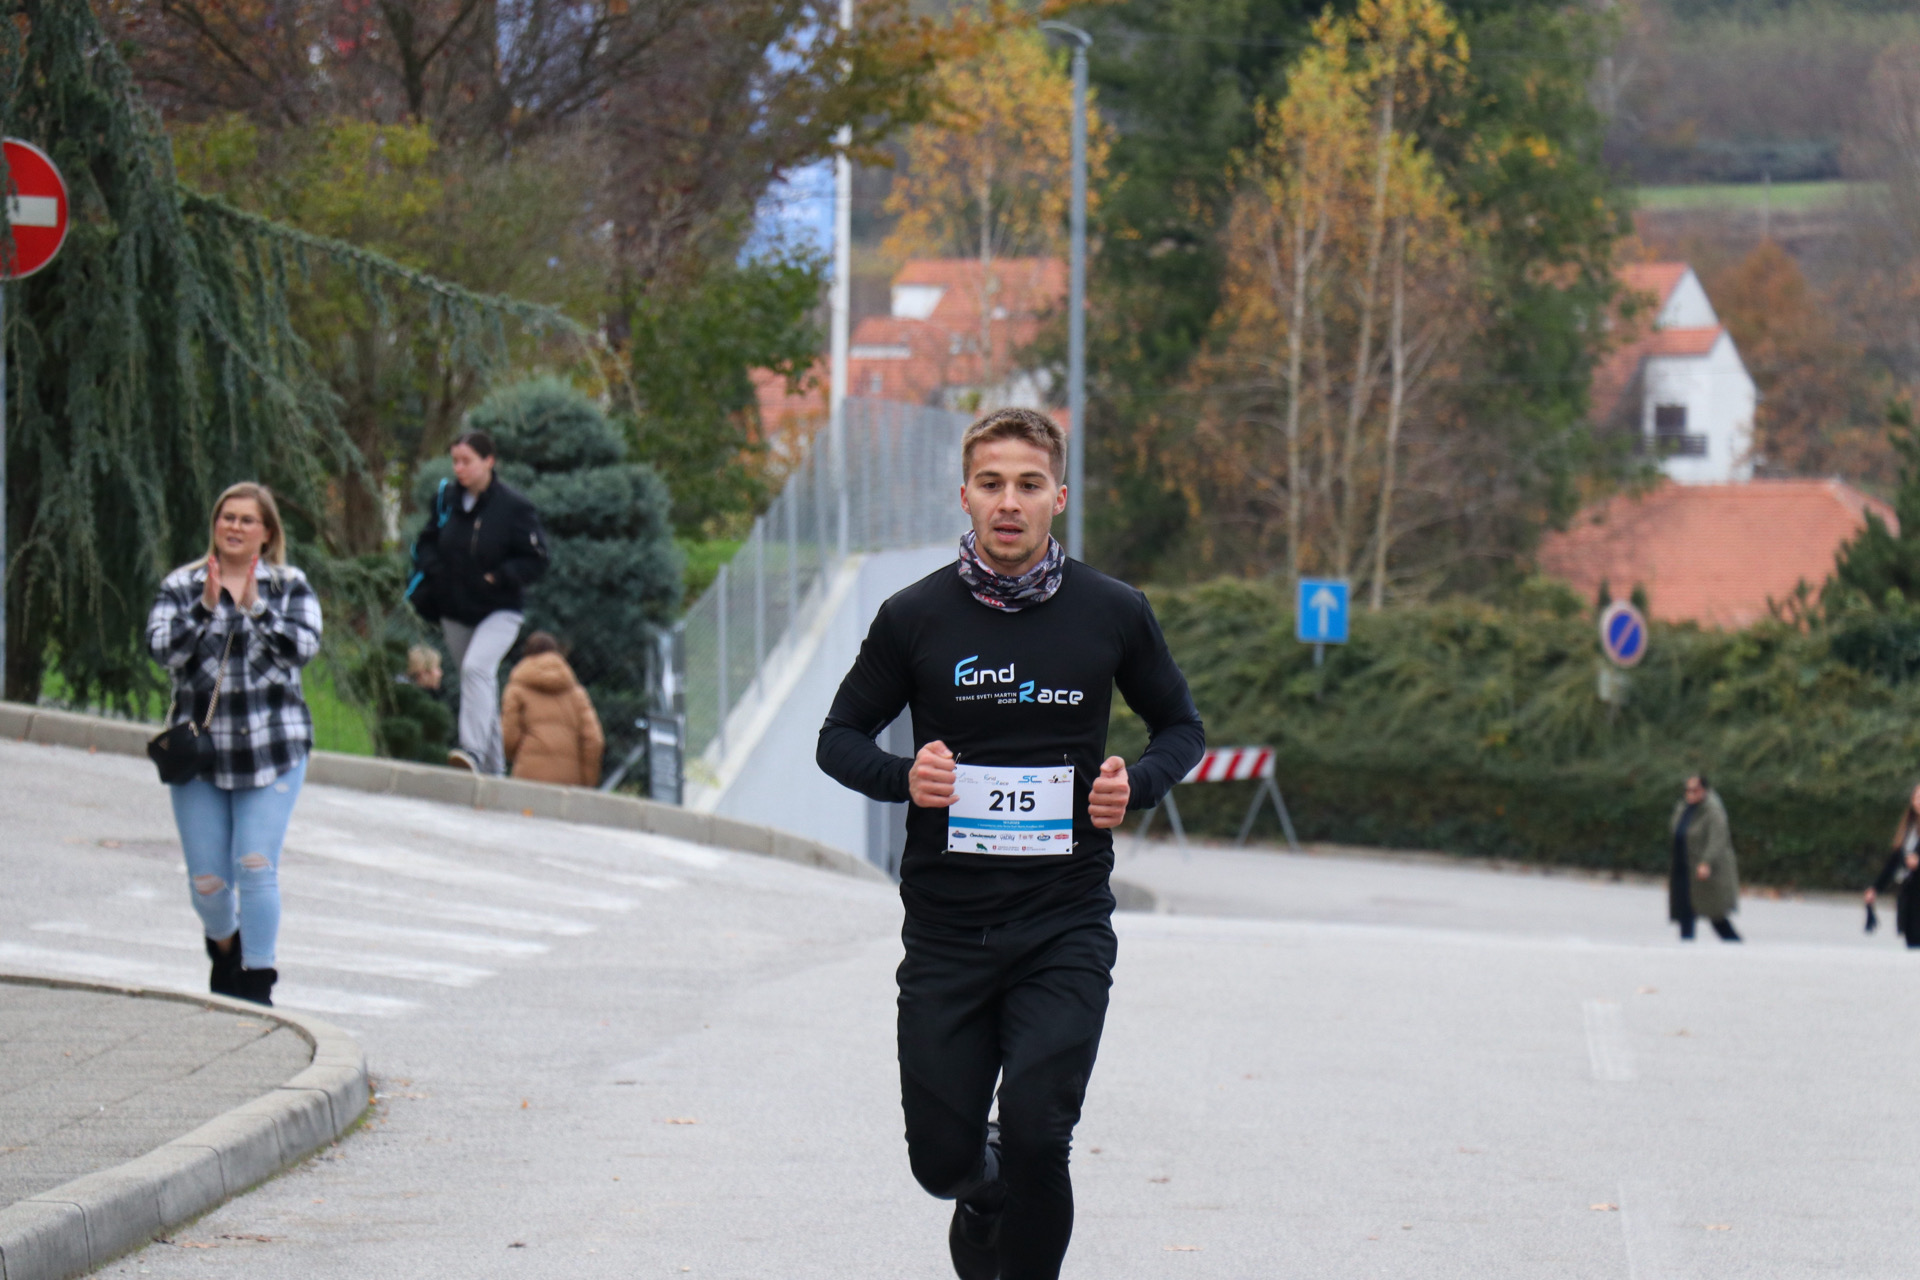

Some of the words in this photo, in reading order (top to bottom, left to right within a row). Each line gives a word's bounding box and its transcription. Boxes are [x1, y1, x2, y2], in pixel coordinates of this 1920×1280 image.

[954, 654, 1015, 686] Fund
[1019, 680, 1084, 705] Race
[1018, 775, 1042, 784] SC
[988, 789, 1036, 813] 215
